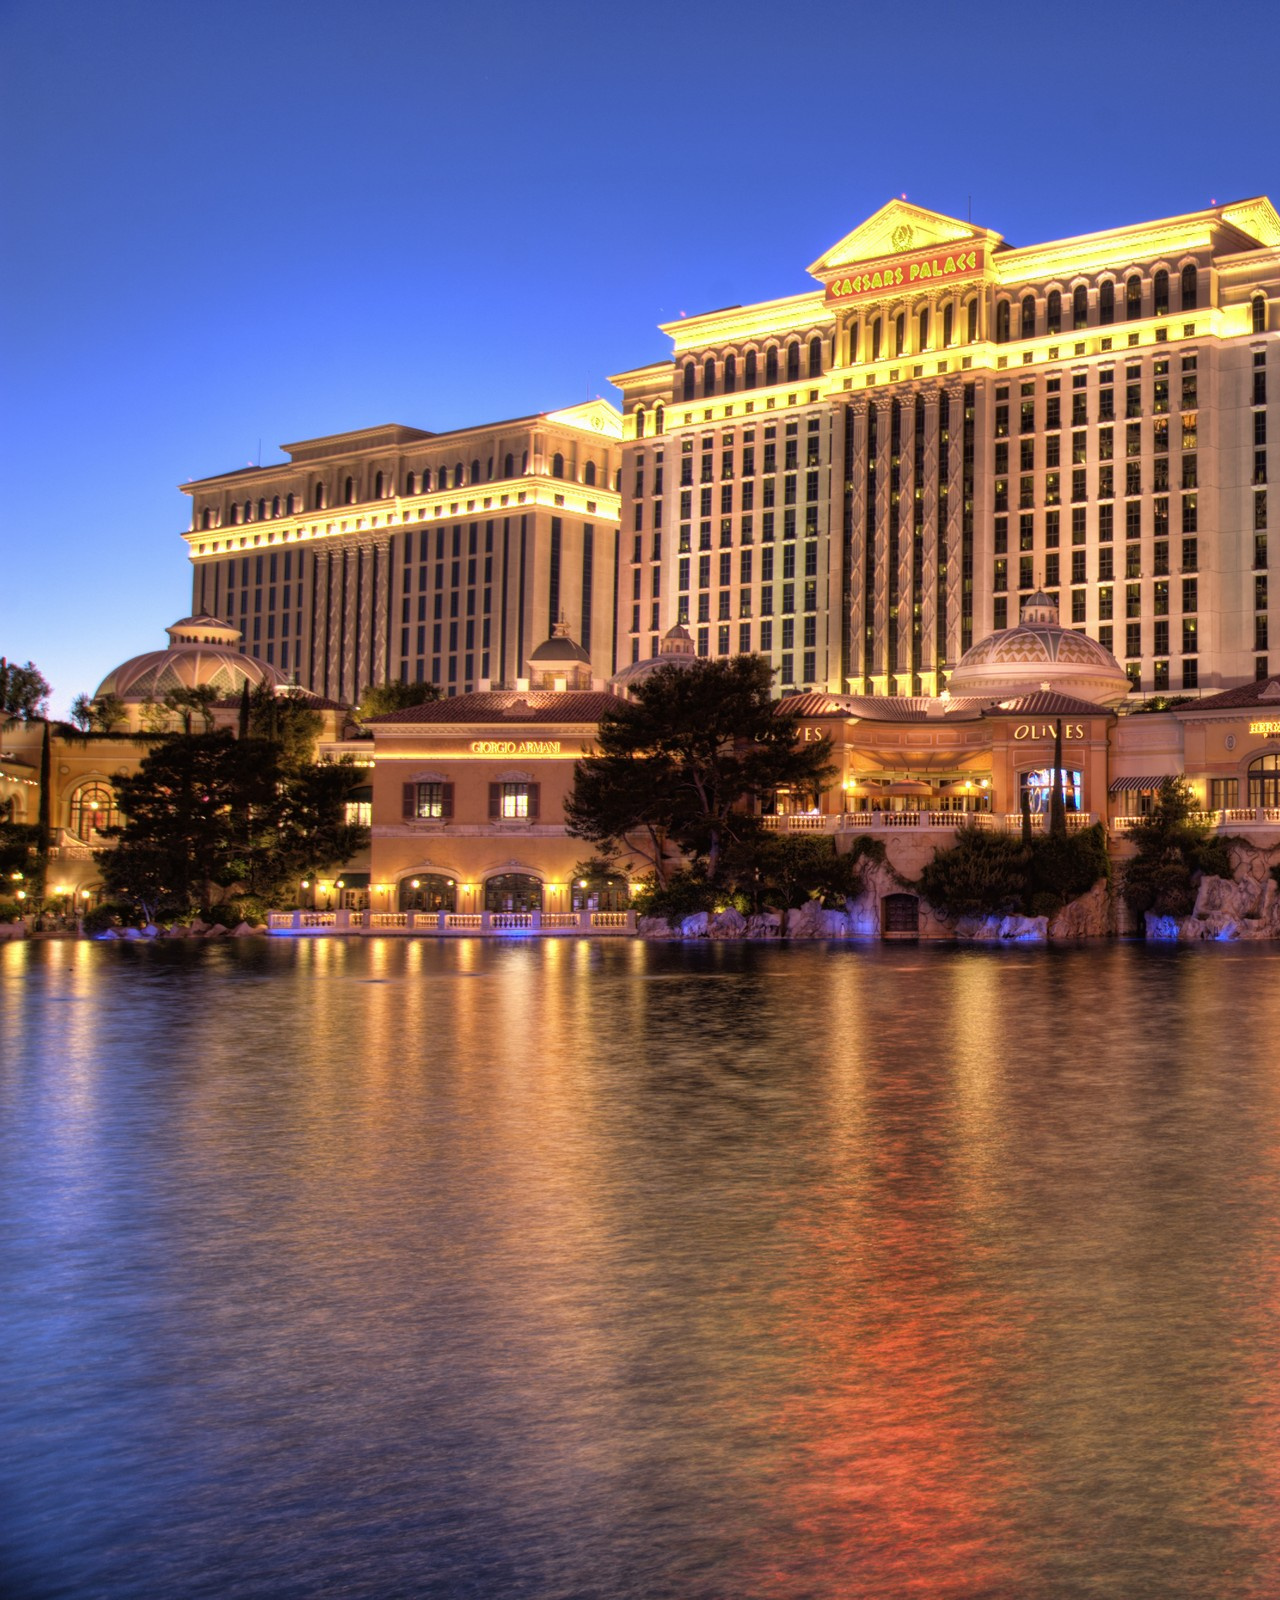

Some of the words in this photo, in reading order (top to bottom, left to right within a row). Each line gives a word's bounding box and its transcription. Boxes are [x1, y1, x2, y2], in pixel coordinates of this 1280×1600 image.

[831, 267, 904, 297] CAESARS
[909, 251, 976, 281] PALACE
[471, 741, 517, 754] GIORGIO
[519, 741, 561, 754] ARMANI
